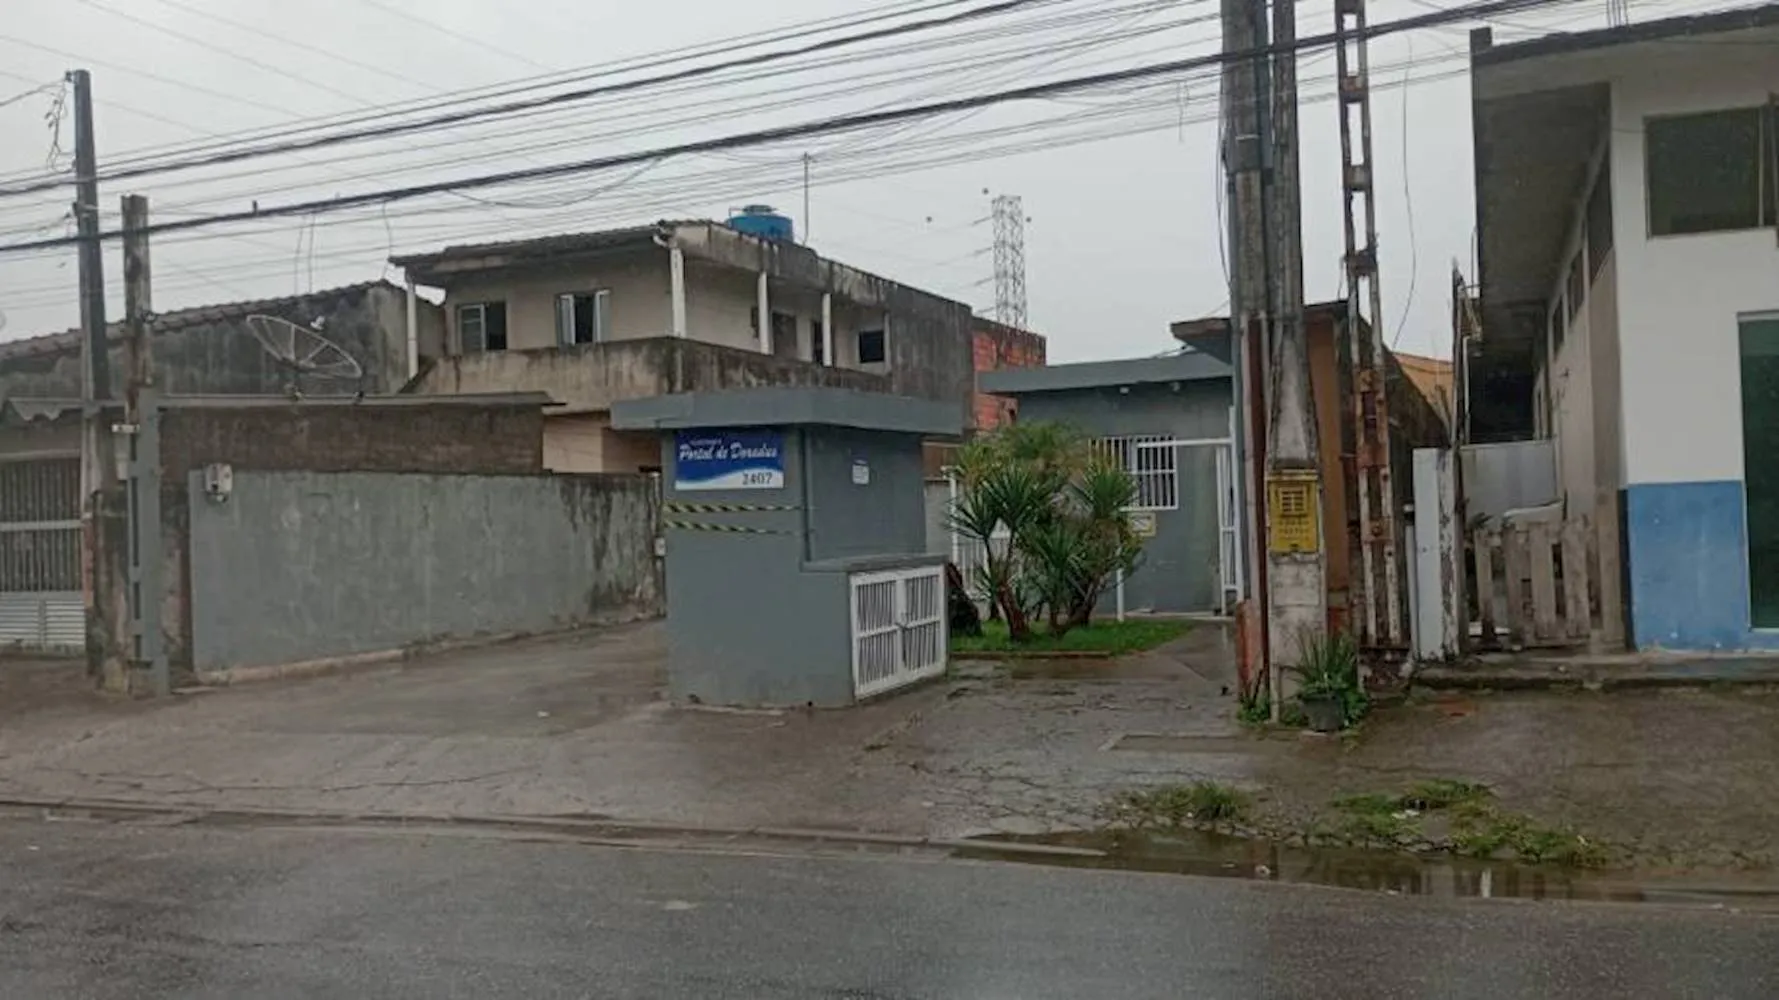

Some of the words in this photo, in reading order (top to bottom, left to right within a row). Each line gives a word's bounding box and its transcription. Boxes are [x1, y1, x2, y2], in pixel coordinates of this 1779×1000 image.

[680, 443, 714, 461] Portal
[716, 444, 728, 460] de
[742, 472, 773, 485] 2407
